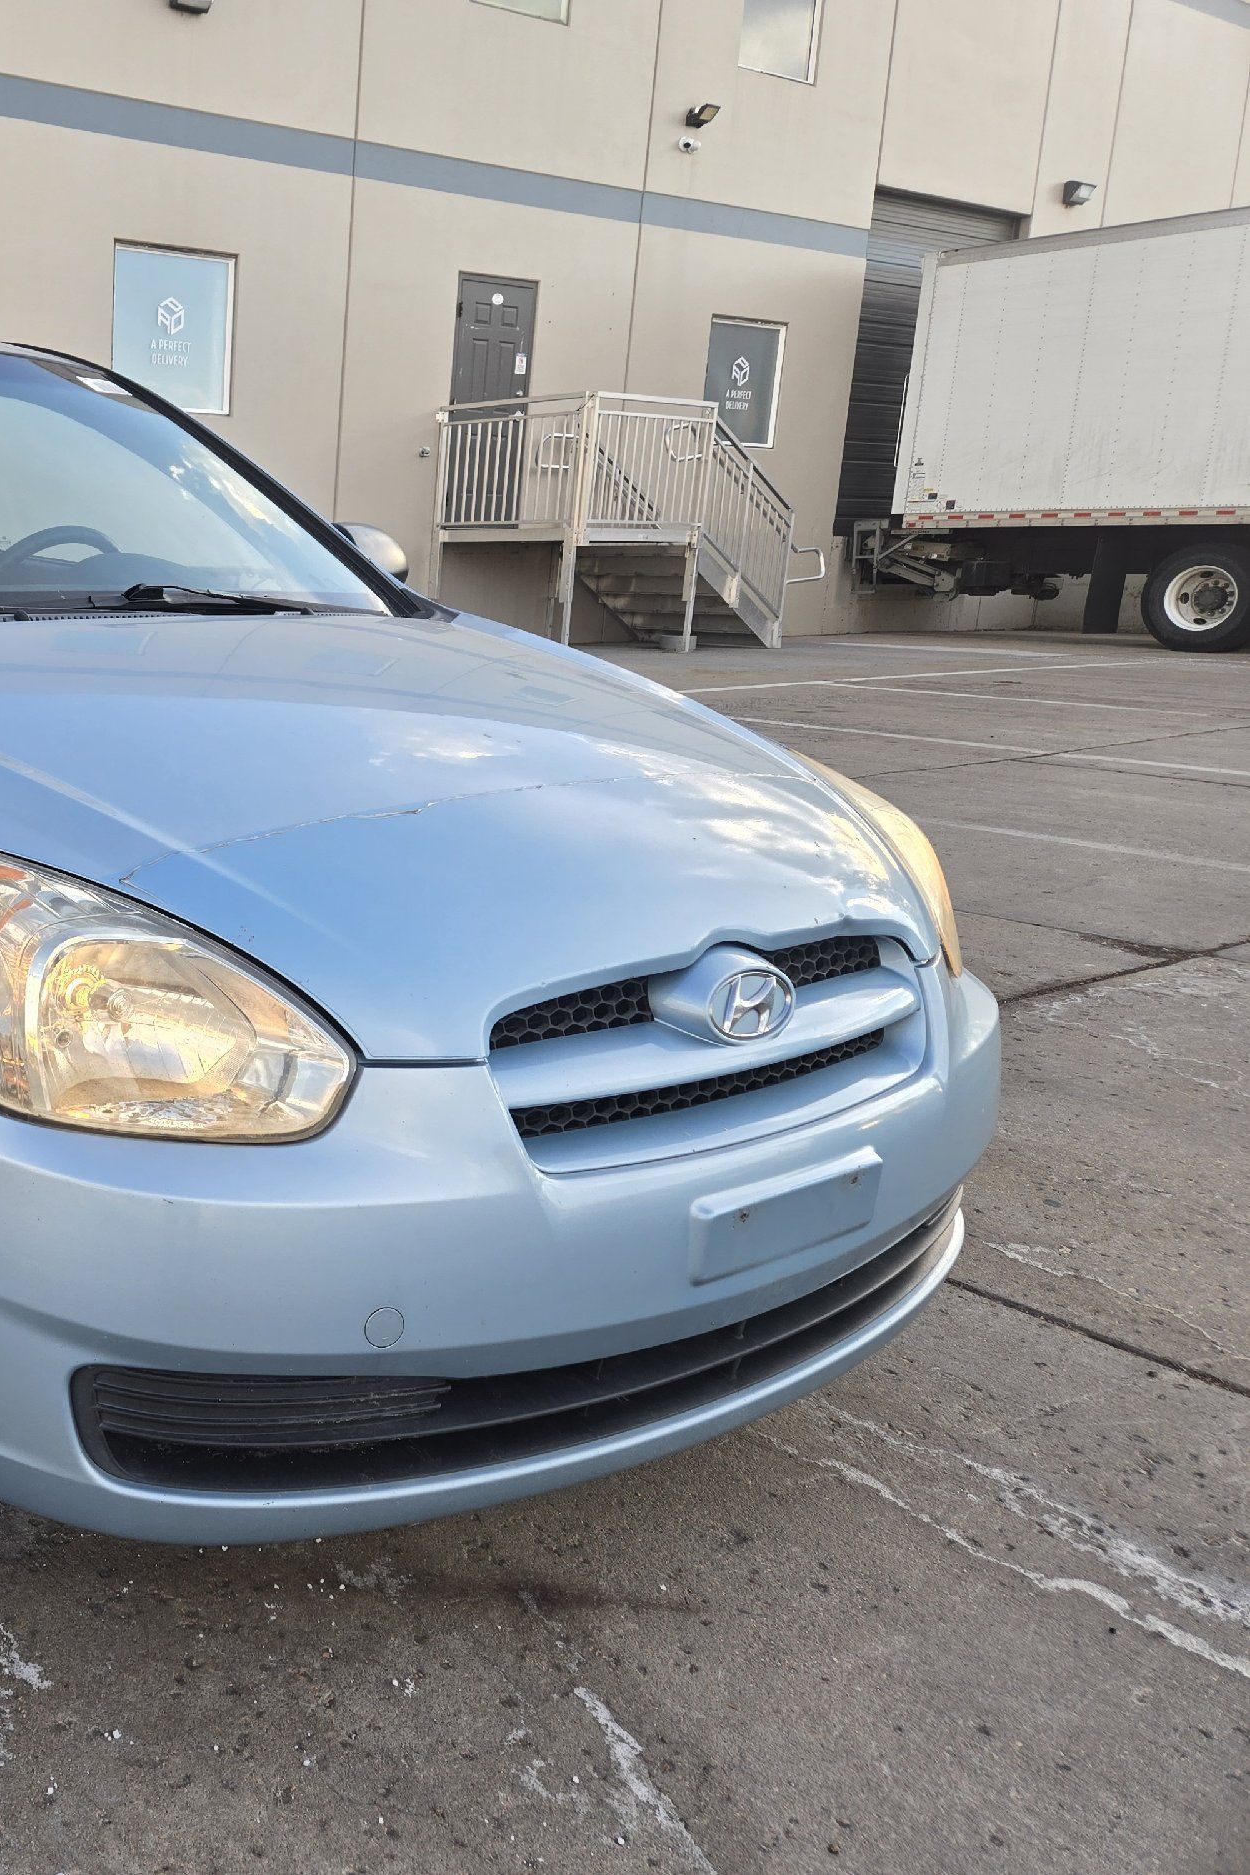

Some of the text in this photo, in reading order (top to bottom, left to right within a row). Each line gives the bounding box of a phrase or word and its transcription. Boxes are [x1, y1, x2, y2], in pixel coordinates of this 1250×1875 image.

[150, 338, 191, 353] A PERFECT
[151, 353, 189, 366] DELIVERY
[725, 400, 749, 410] DELIVERY
